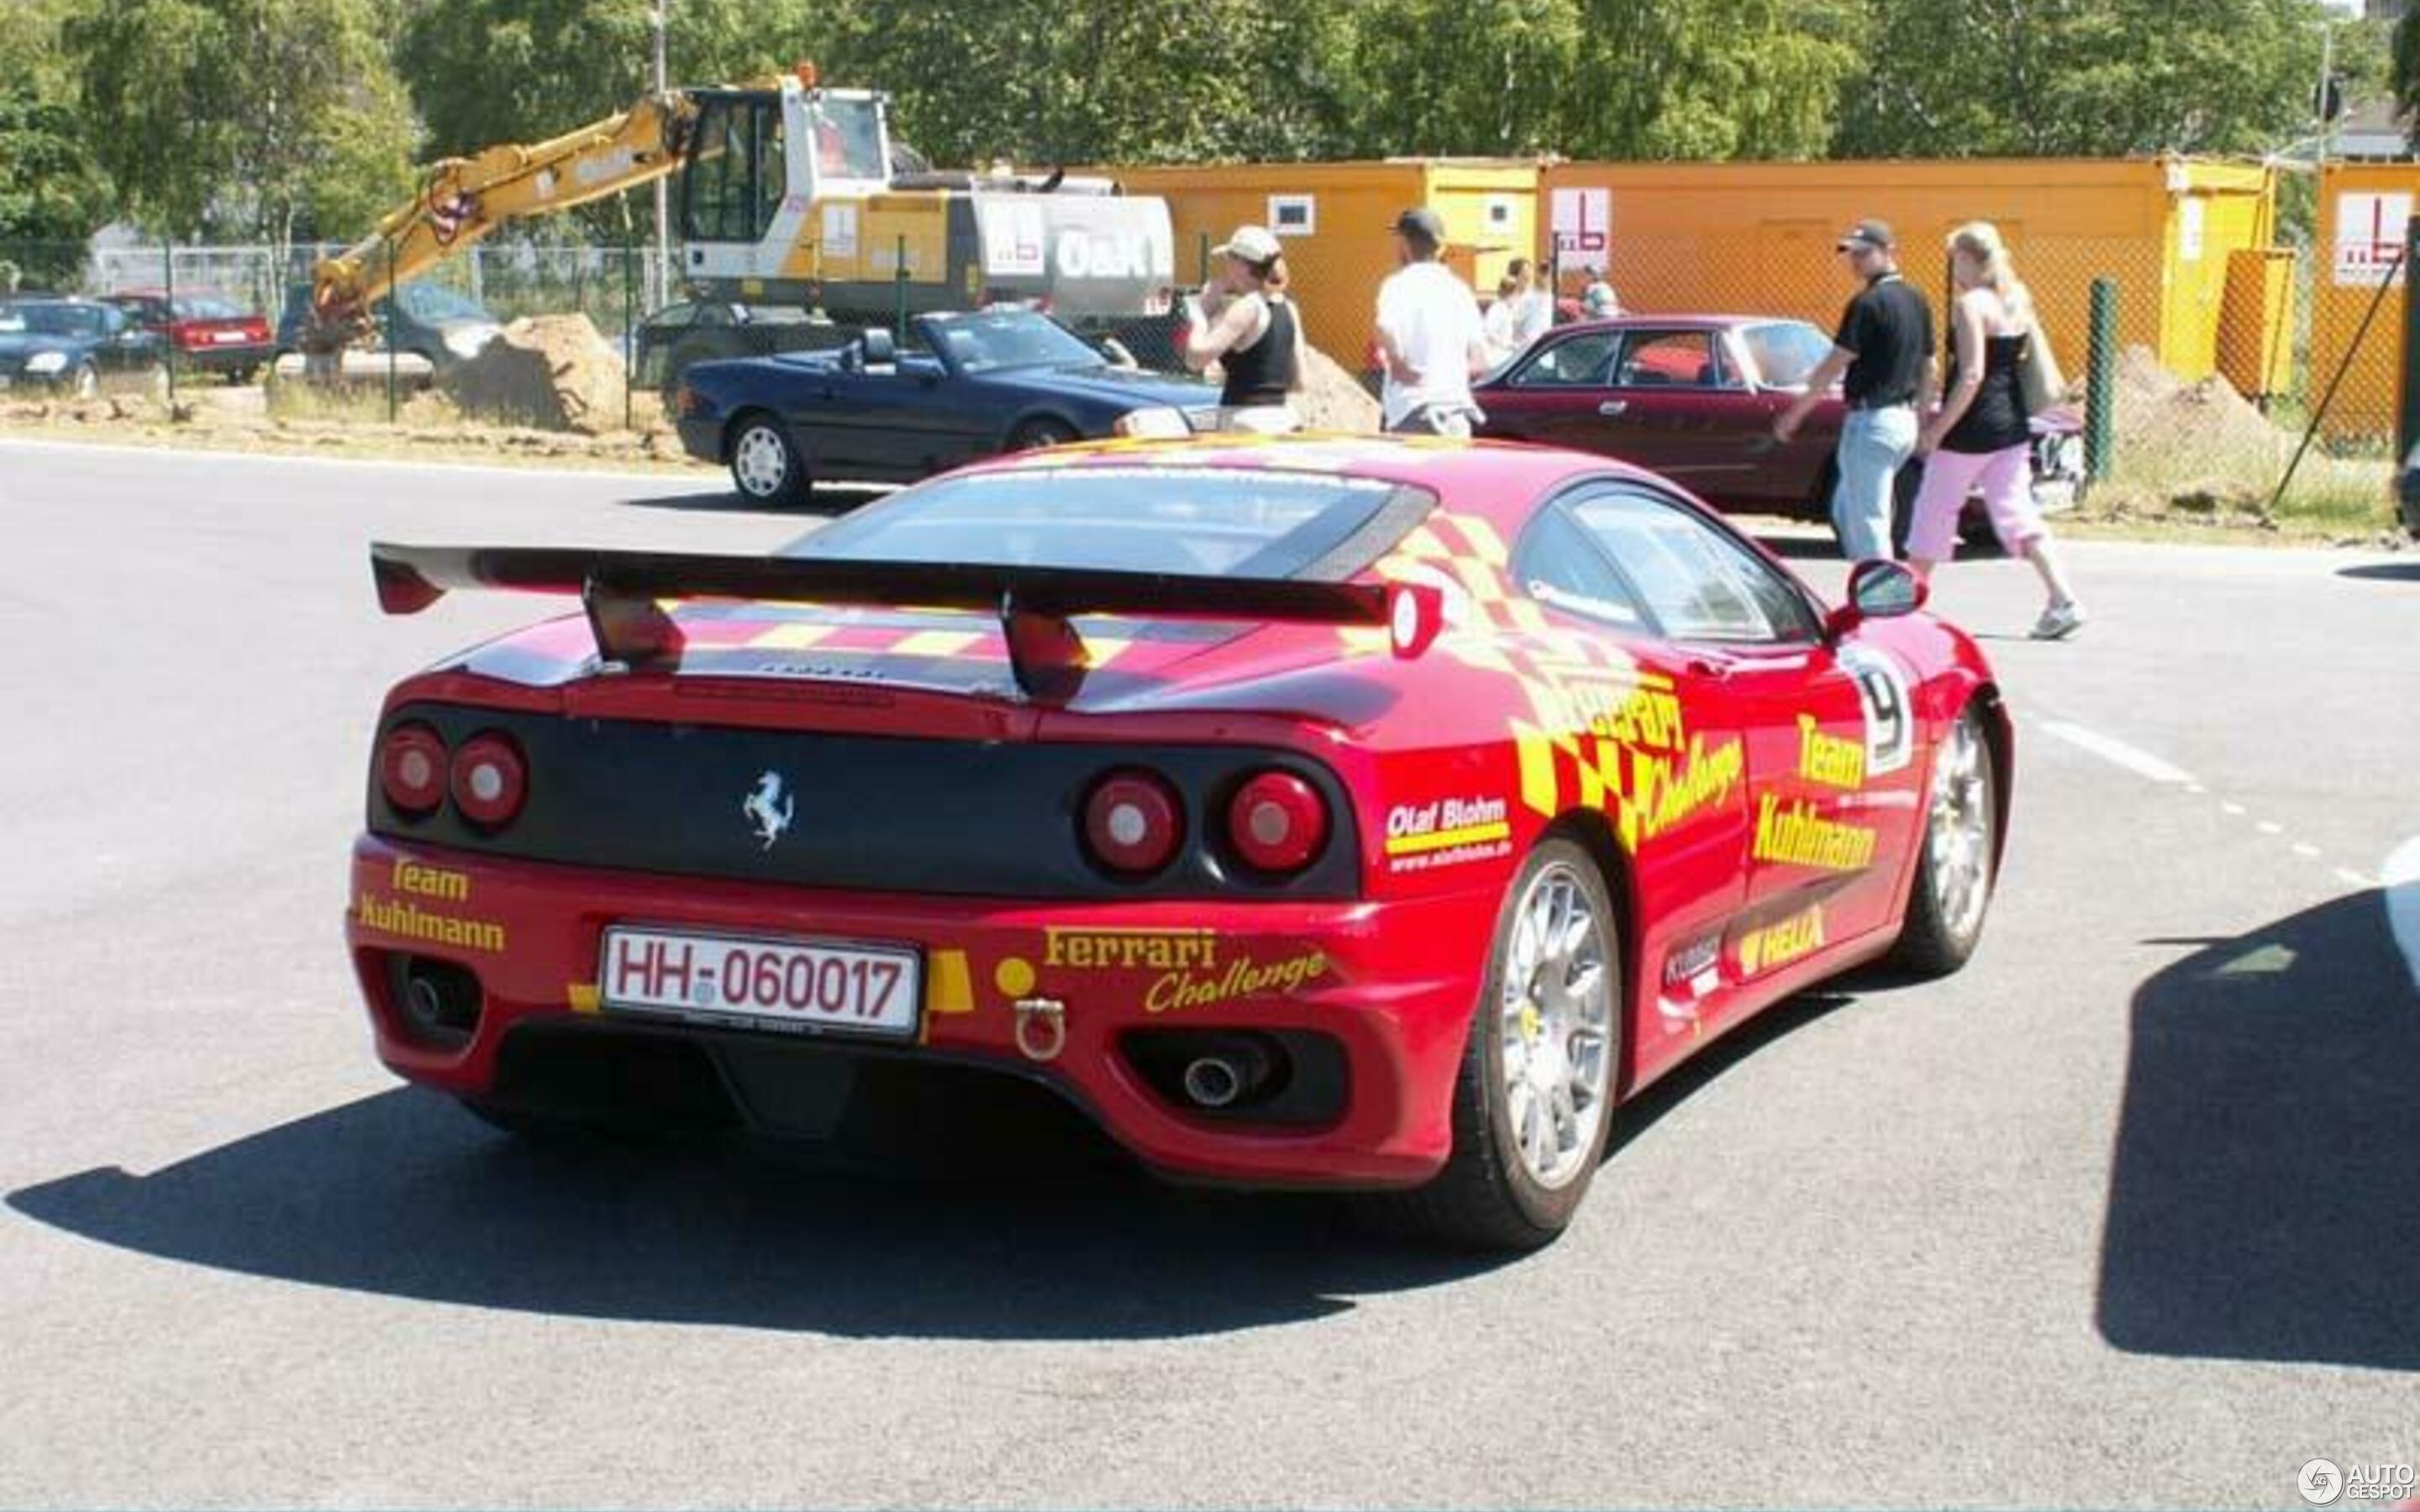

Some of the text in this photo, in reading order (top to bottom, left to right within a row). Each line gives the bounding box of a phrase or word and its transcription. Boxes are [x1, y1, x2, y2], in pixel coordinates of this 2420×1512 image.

[1796, 711, 1865, 789] Team
[1387, 794, 1506, 837] Olaf Blohm
[1753, 790, 1876, 871] Kuhlmann
[392, 855, 467, 900] Team
[359, 891, 504, 951] Kuhlmann
[1044, 925, 1218, 968] Ferrari
[1144, 950, 1325, 1014] Challenge
